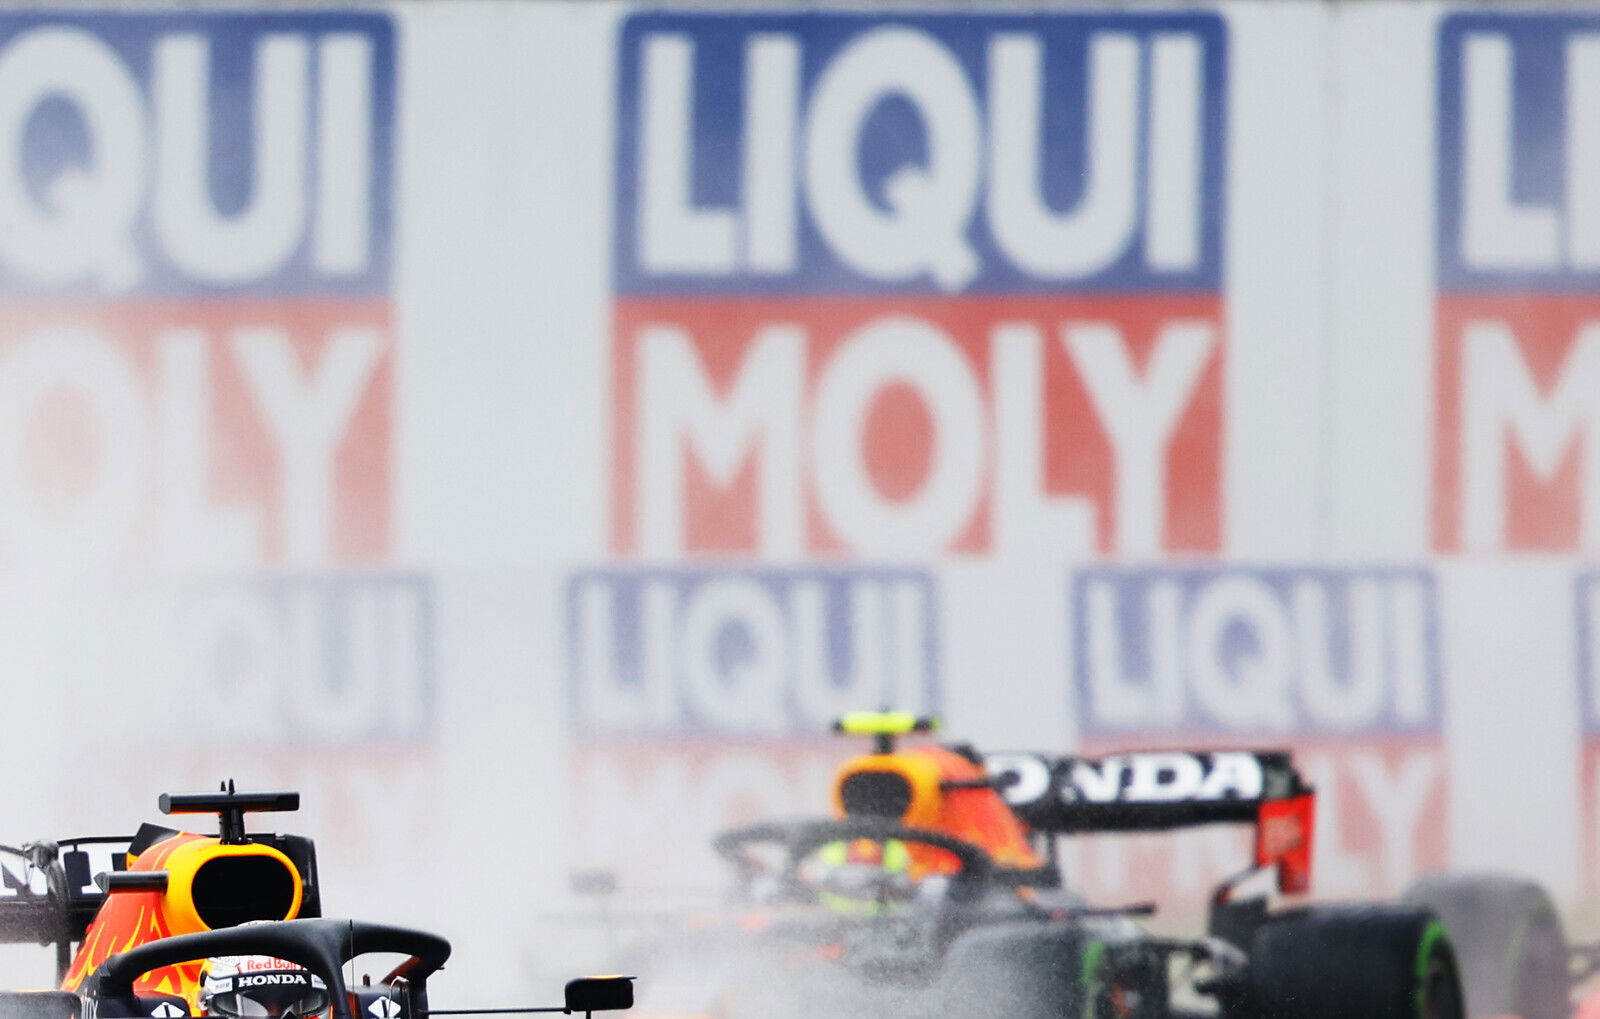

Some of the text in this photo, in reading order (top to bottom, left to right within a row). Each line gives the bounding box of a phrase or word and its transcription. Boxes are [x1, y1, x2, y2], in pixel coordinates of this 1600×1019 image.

[640, 24, 1203, 294] LIQUI
[635, 315, 1218, 564] MOLY
[193, 586, 419, 734] QUI
[581, 580, 924, 734] LIQUI
[1092, 576, 1422, 732] LIQUI
[983, 752, 1263, 803] ONDA
[238, 974, 307, 988] HONDA
[247, 959, 272, 971] Red
